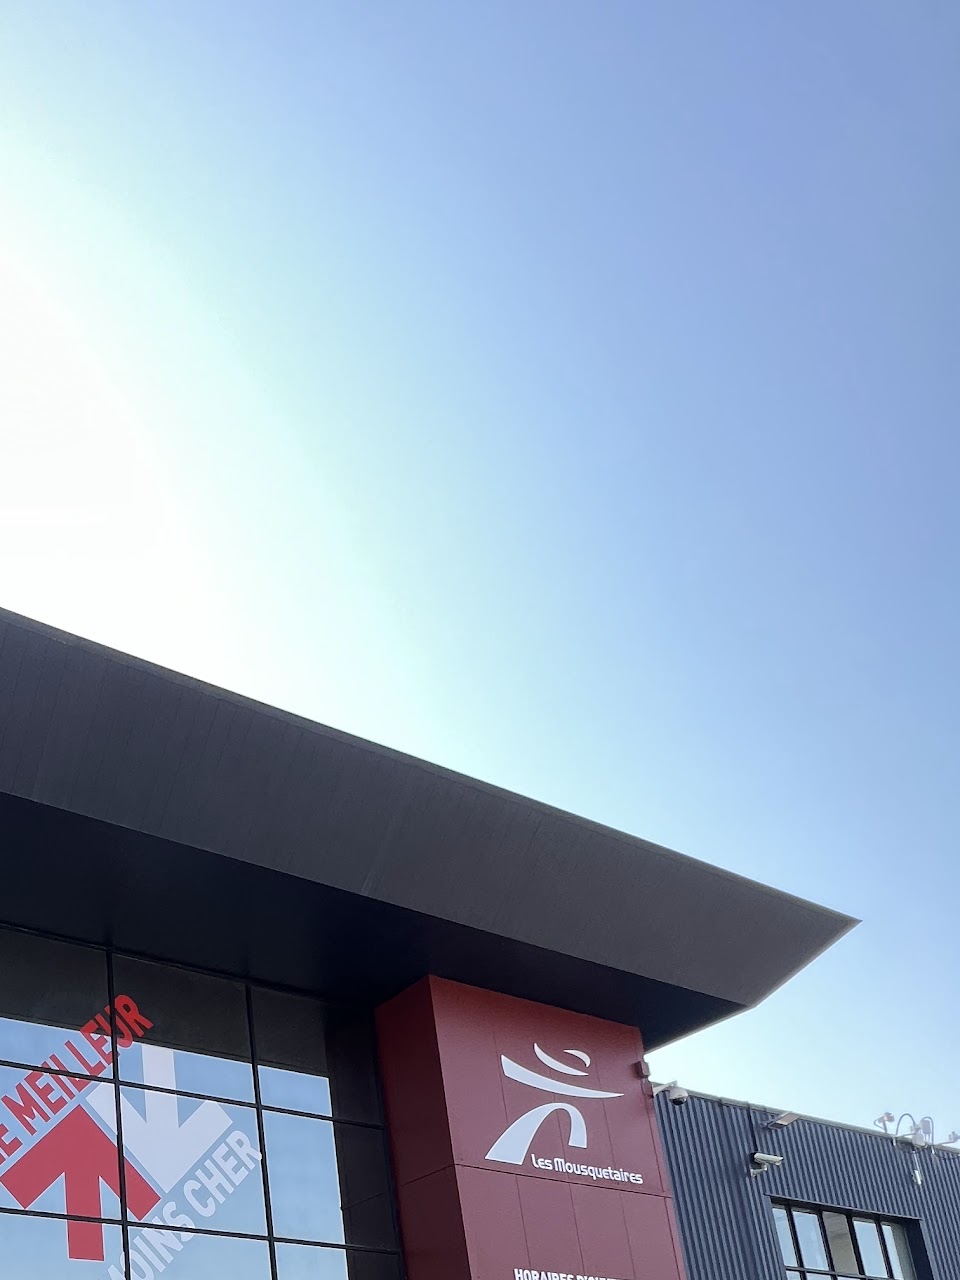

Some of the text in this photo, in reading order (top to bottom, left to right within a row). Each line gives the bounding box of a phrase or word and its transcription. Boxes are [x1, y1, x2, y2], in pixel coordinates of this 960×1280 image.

[0, 994, 154, 1136] MEILLEUR
[183, 1130, 263, 1218] CHER
[531, 1153, 644, 1185] Les Mousquetaires
